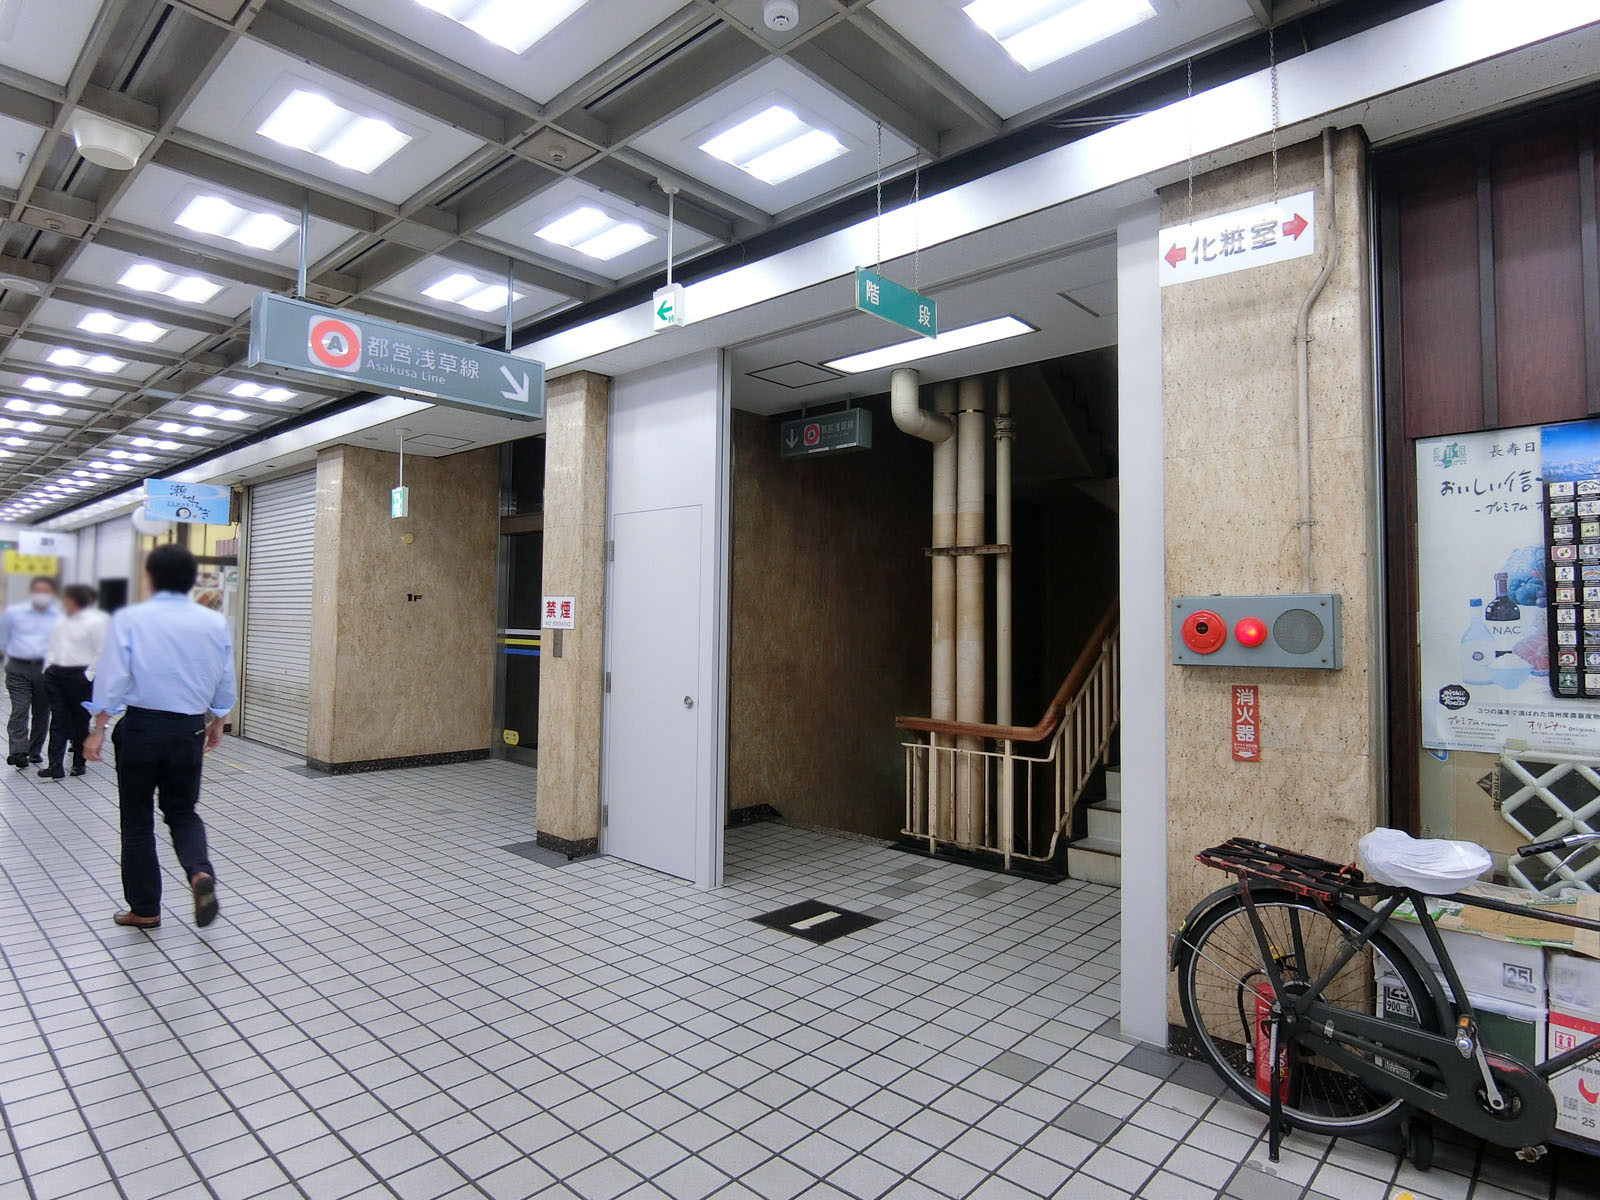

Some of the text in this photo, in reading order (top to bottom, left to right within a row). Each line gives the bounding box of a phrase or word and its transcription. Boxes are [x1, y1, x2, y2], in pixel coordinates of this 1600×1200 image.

[1191, 219, 1278, 265] 化粧室
[326, 335, 344, 353] A
[367, 335, 480, 380] 都営浅草線
[366, 359, 446, 385] Asakusa Line
[1489, 441, 1536, 458] 長寿日
[1440, 470, 1543, 497] おいしい信
[546, 600, 571, 619] 禁煙
[1236, 688, 1255, 742] 消火器
[1580, 1116, 1596, 1129] 25
